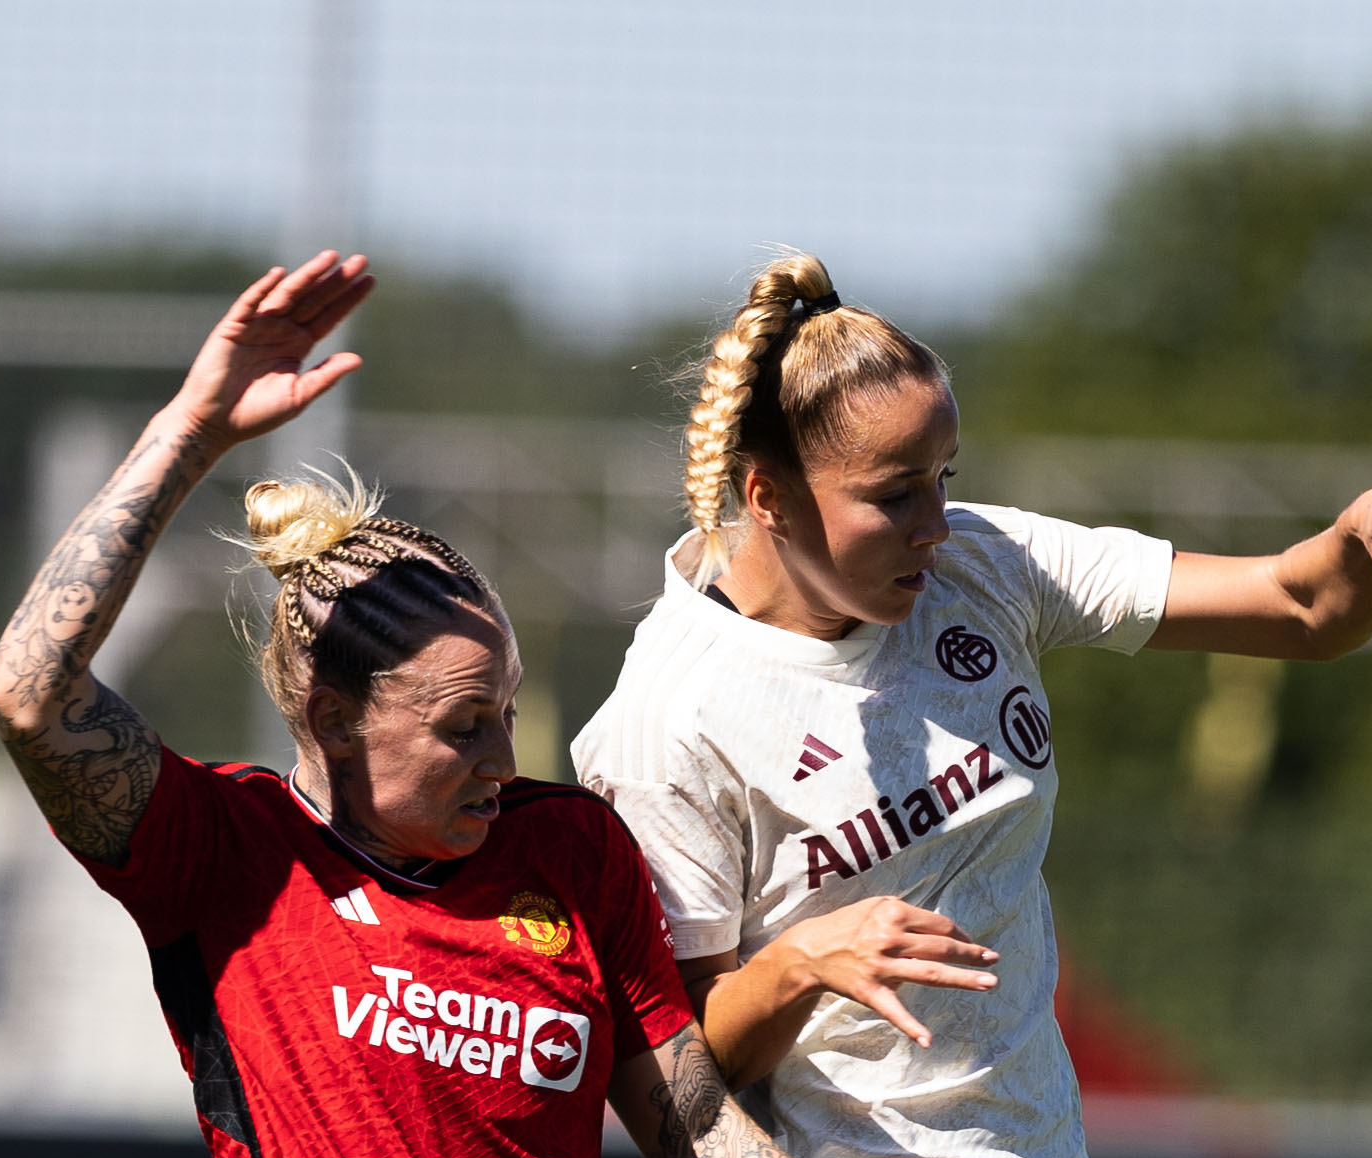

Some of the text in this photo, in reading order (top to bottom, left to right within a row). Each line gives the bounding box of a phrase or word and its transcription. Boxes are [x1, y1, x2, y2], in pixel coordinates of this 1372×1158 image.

[800, 742, 1004, 890] Allianz
[532, 935, 566, 952] UNITED
[332, 985, 517, 1079] Viewer
[371, 964, 520, 1039] Team
